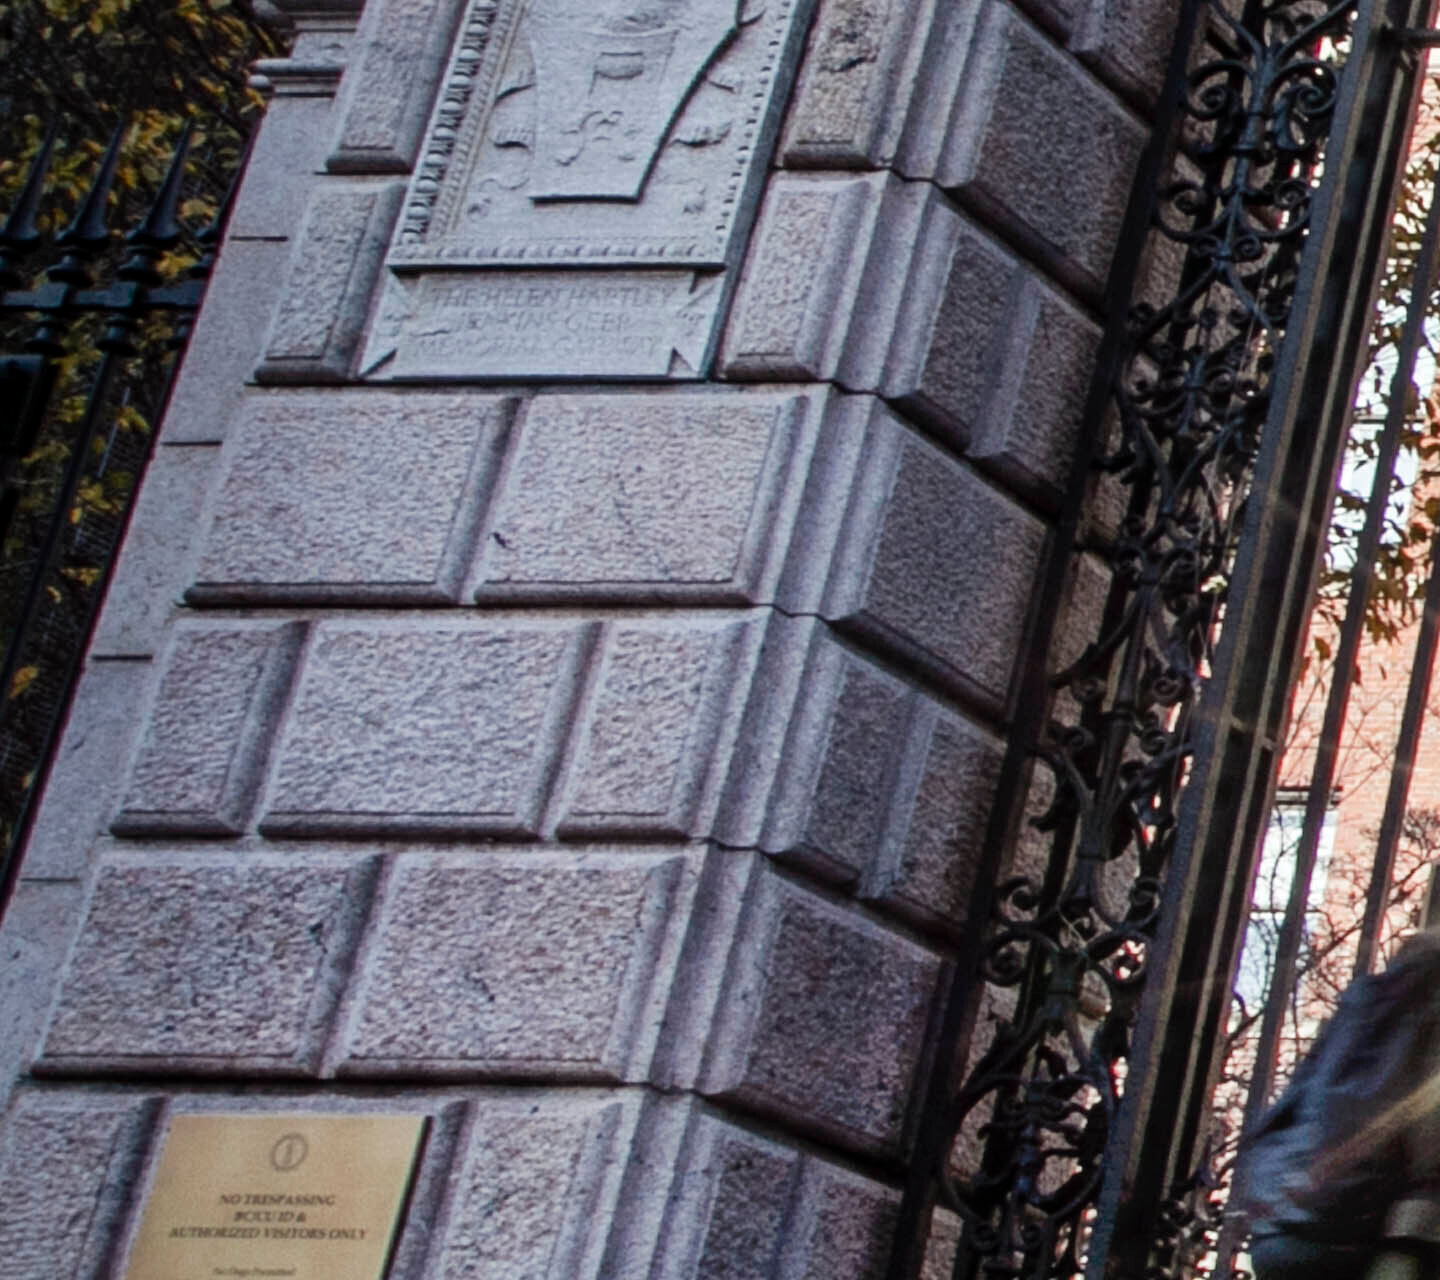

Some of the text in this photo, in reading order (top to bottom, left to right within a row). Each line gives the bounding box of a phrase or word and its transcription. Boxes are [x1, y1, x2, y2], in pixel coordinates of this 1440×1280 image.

[219, 1193, 336, 1206] NO TRESPASSING
[168, 1226, 368, 1240] AUTHORIZED VISITORS ONLY
